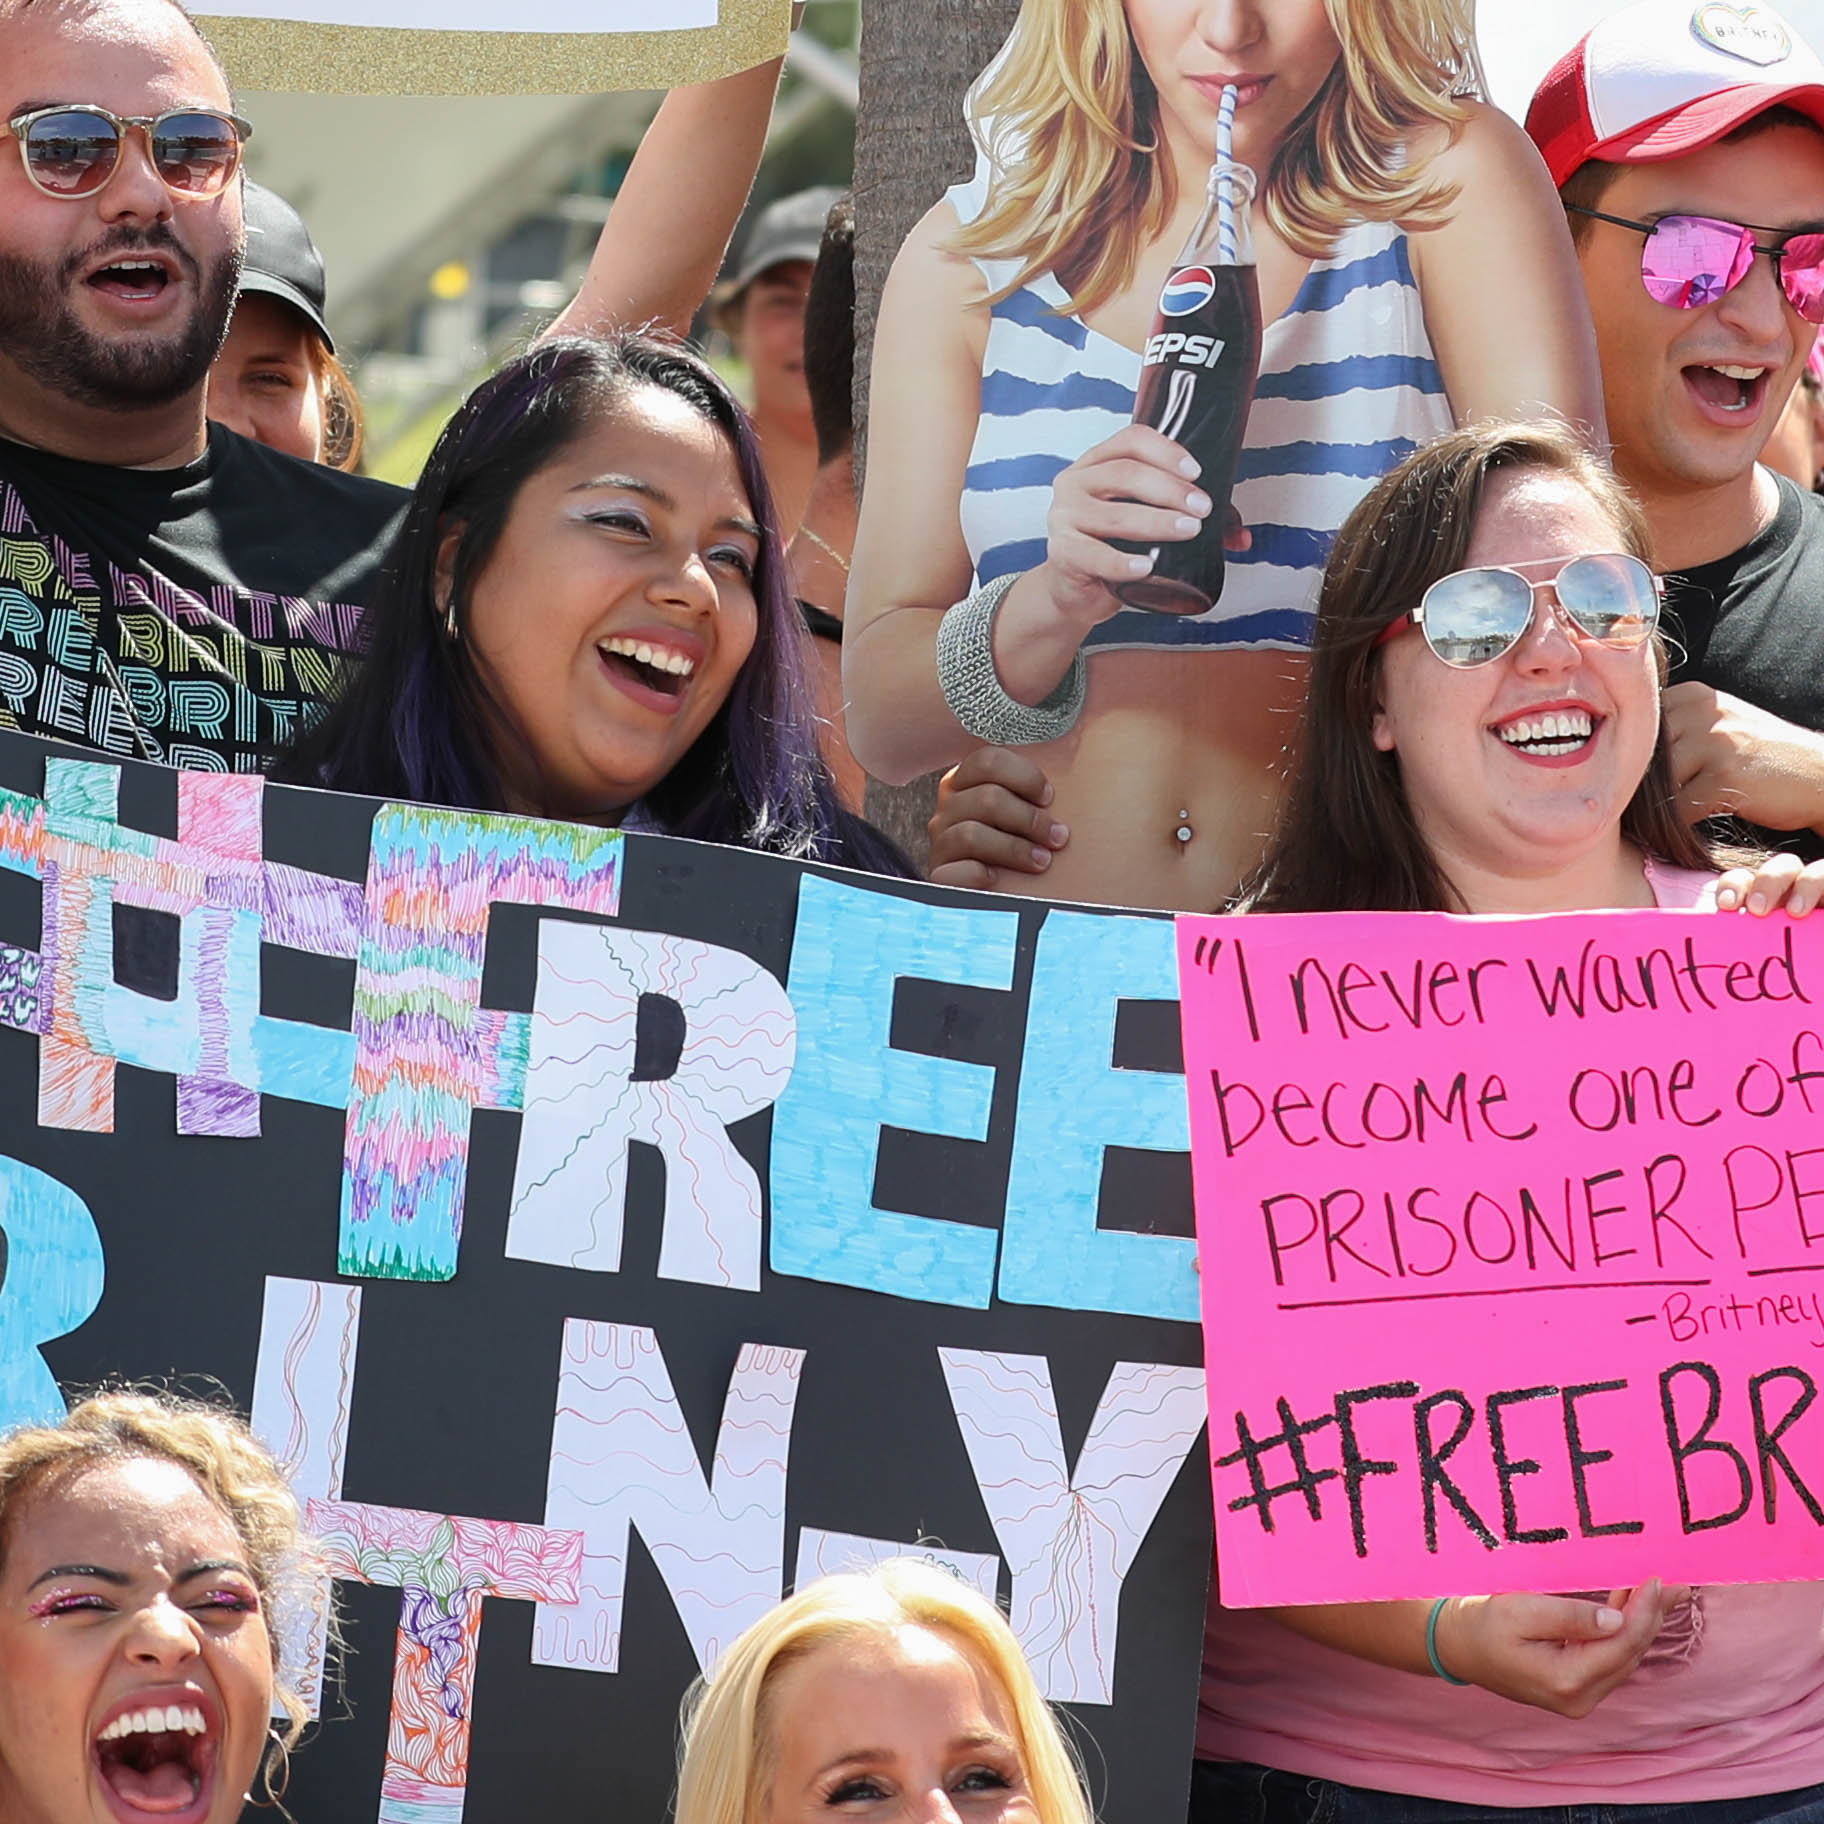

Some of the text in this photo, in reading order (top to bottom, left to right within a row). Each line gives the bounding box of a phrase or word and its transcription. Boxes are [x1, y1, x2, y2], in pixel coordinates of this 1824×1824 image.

[1143, 333, 1225, 368] EPSI
[1291, 959, 1506, 1039] never
[1541, 926, 1805, 1018] wanted
[1212, 1067, 1537, 1157] become
[1570, 1060, 1721, 1133] one
[1262, 1153, 1713, 1288] PRISONER
